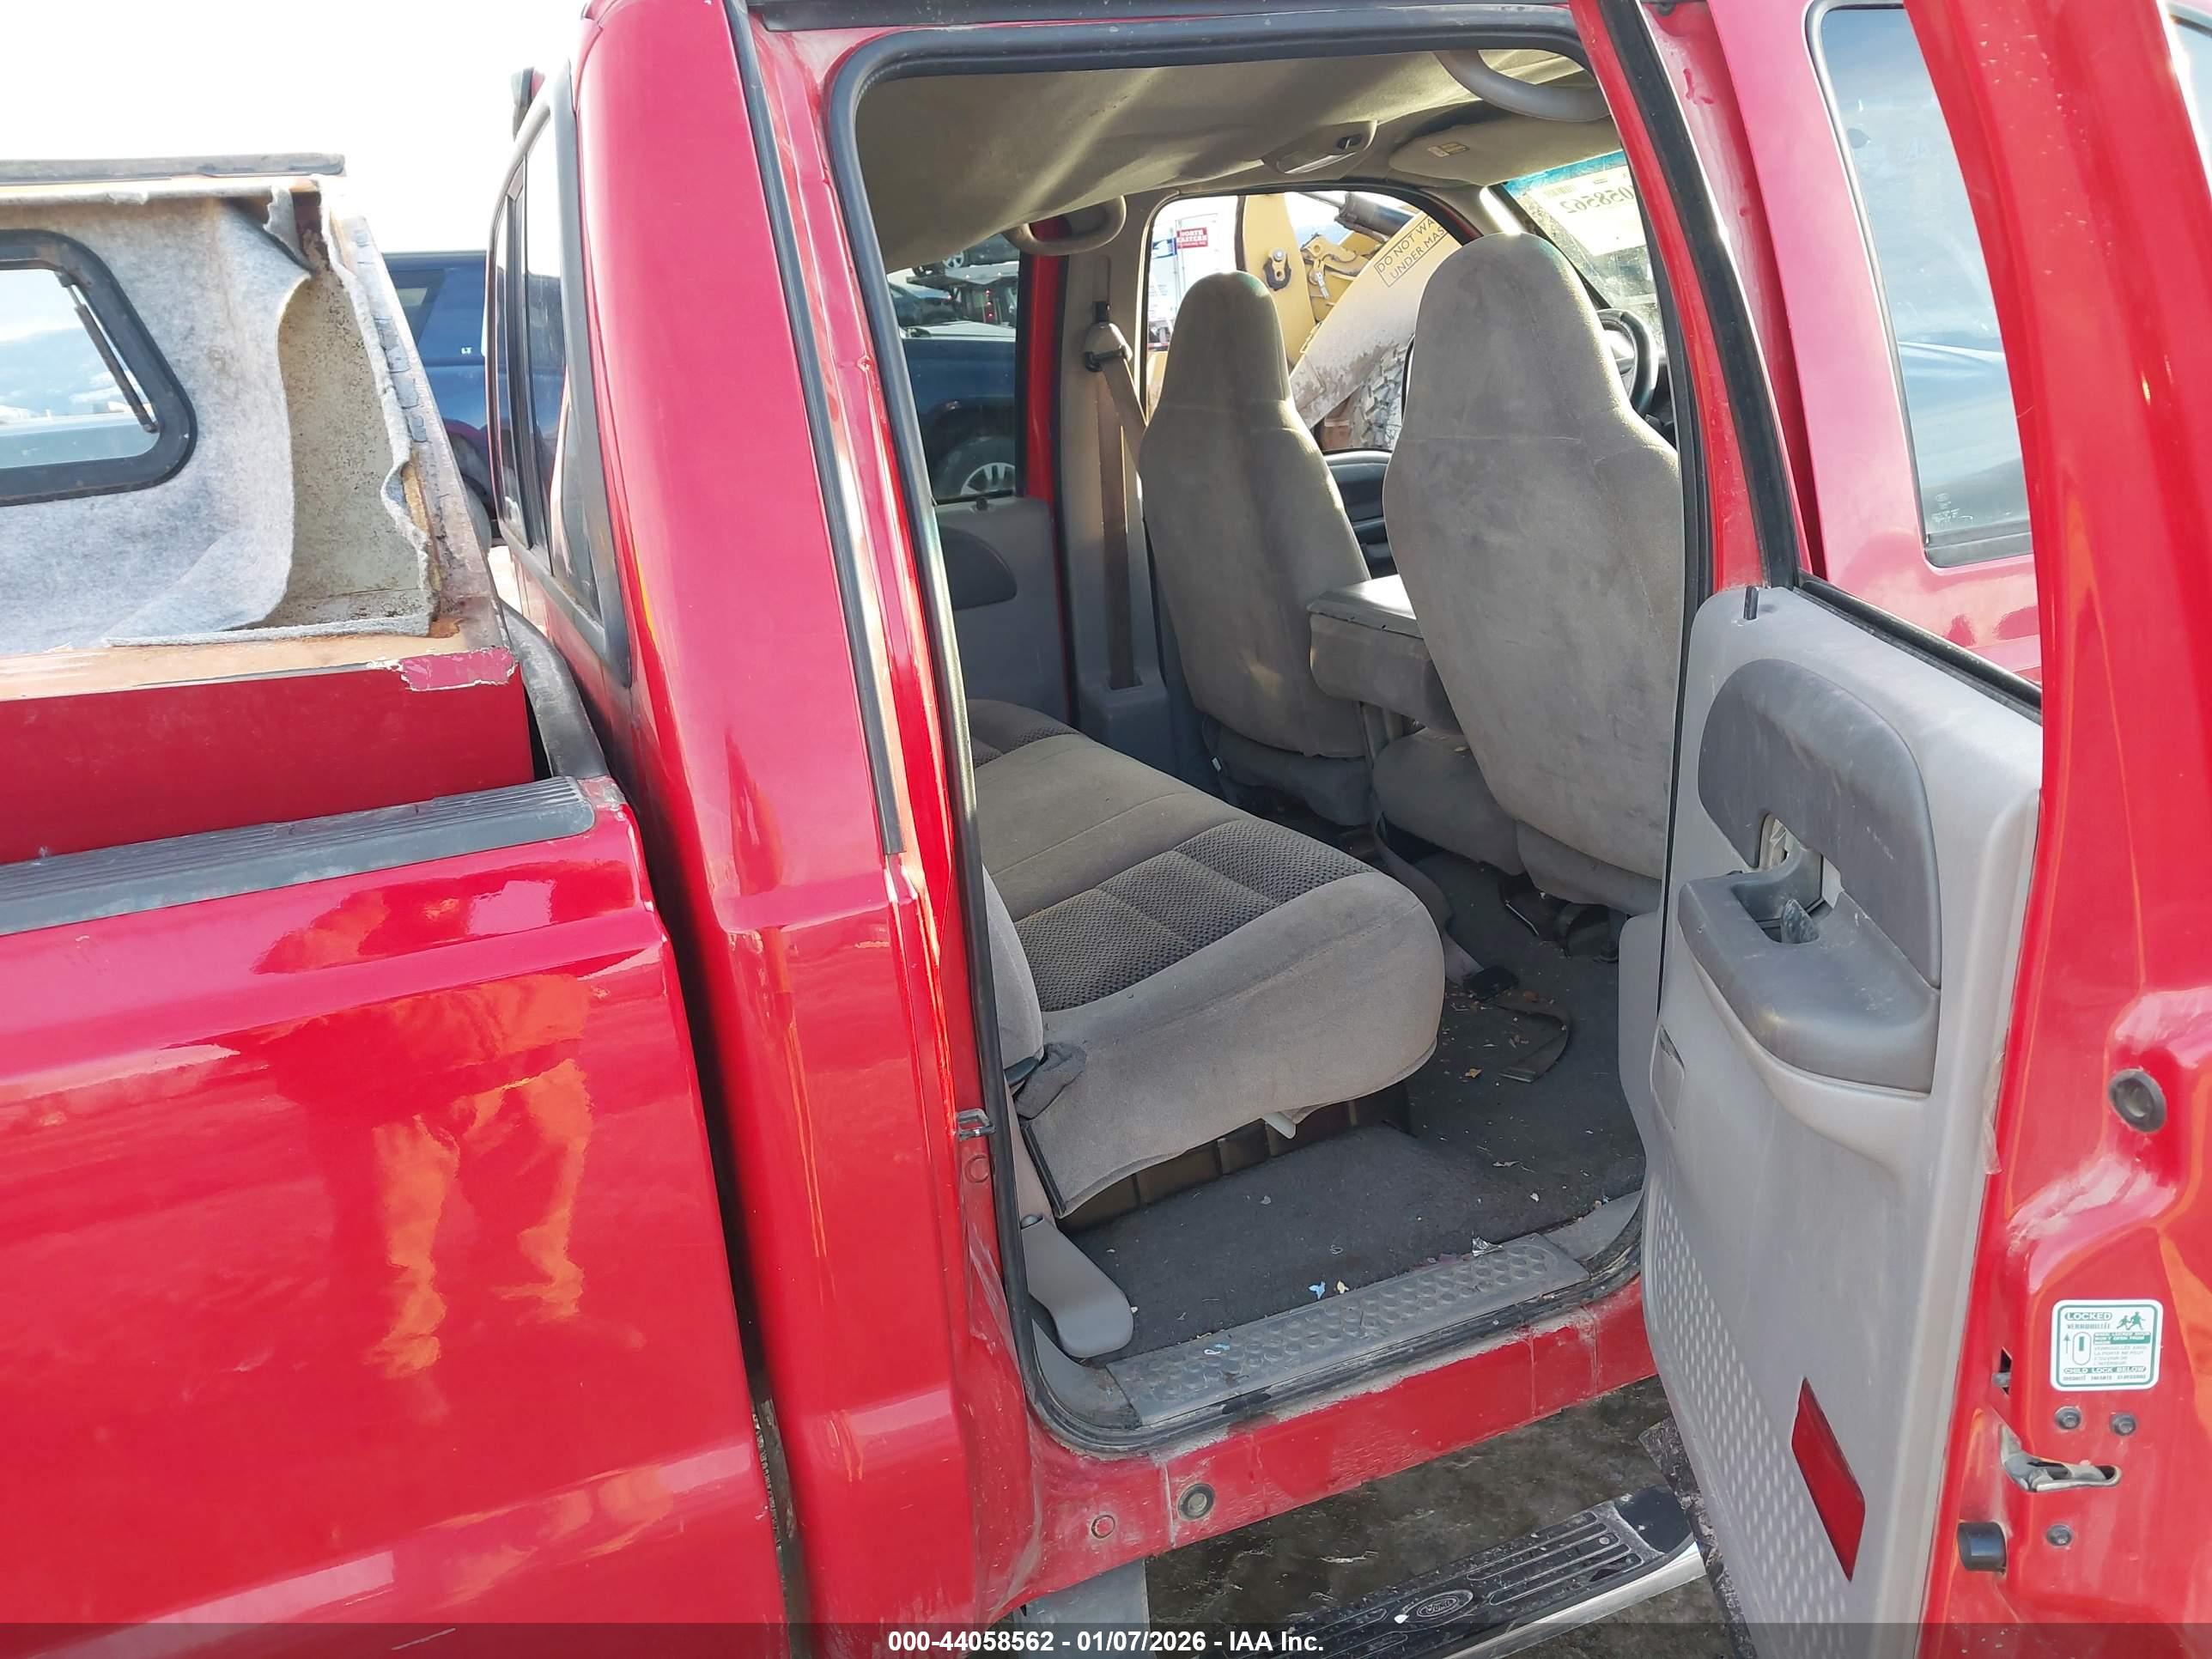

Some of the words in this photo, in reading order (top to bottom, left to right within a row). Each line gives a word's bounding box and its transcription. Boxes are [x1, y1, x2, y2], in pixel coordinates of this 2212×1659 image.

[1376, 255, 1393, 273] DO
[1393, 234, 1415, 257] NOT
[1415, 218, 1435, 234] WA
[1390, 246, 1424, 279] UNDER
[1423, 228, 1445, 248] MAS
[2066, 1312, 2112, 1321] LOCKED
[1419, 1598, 1457, 1614] Ford
